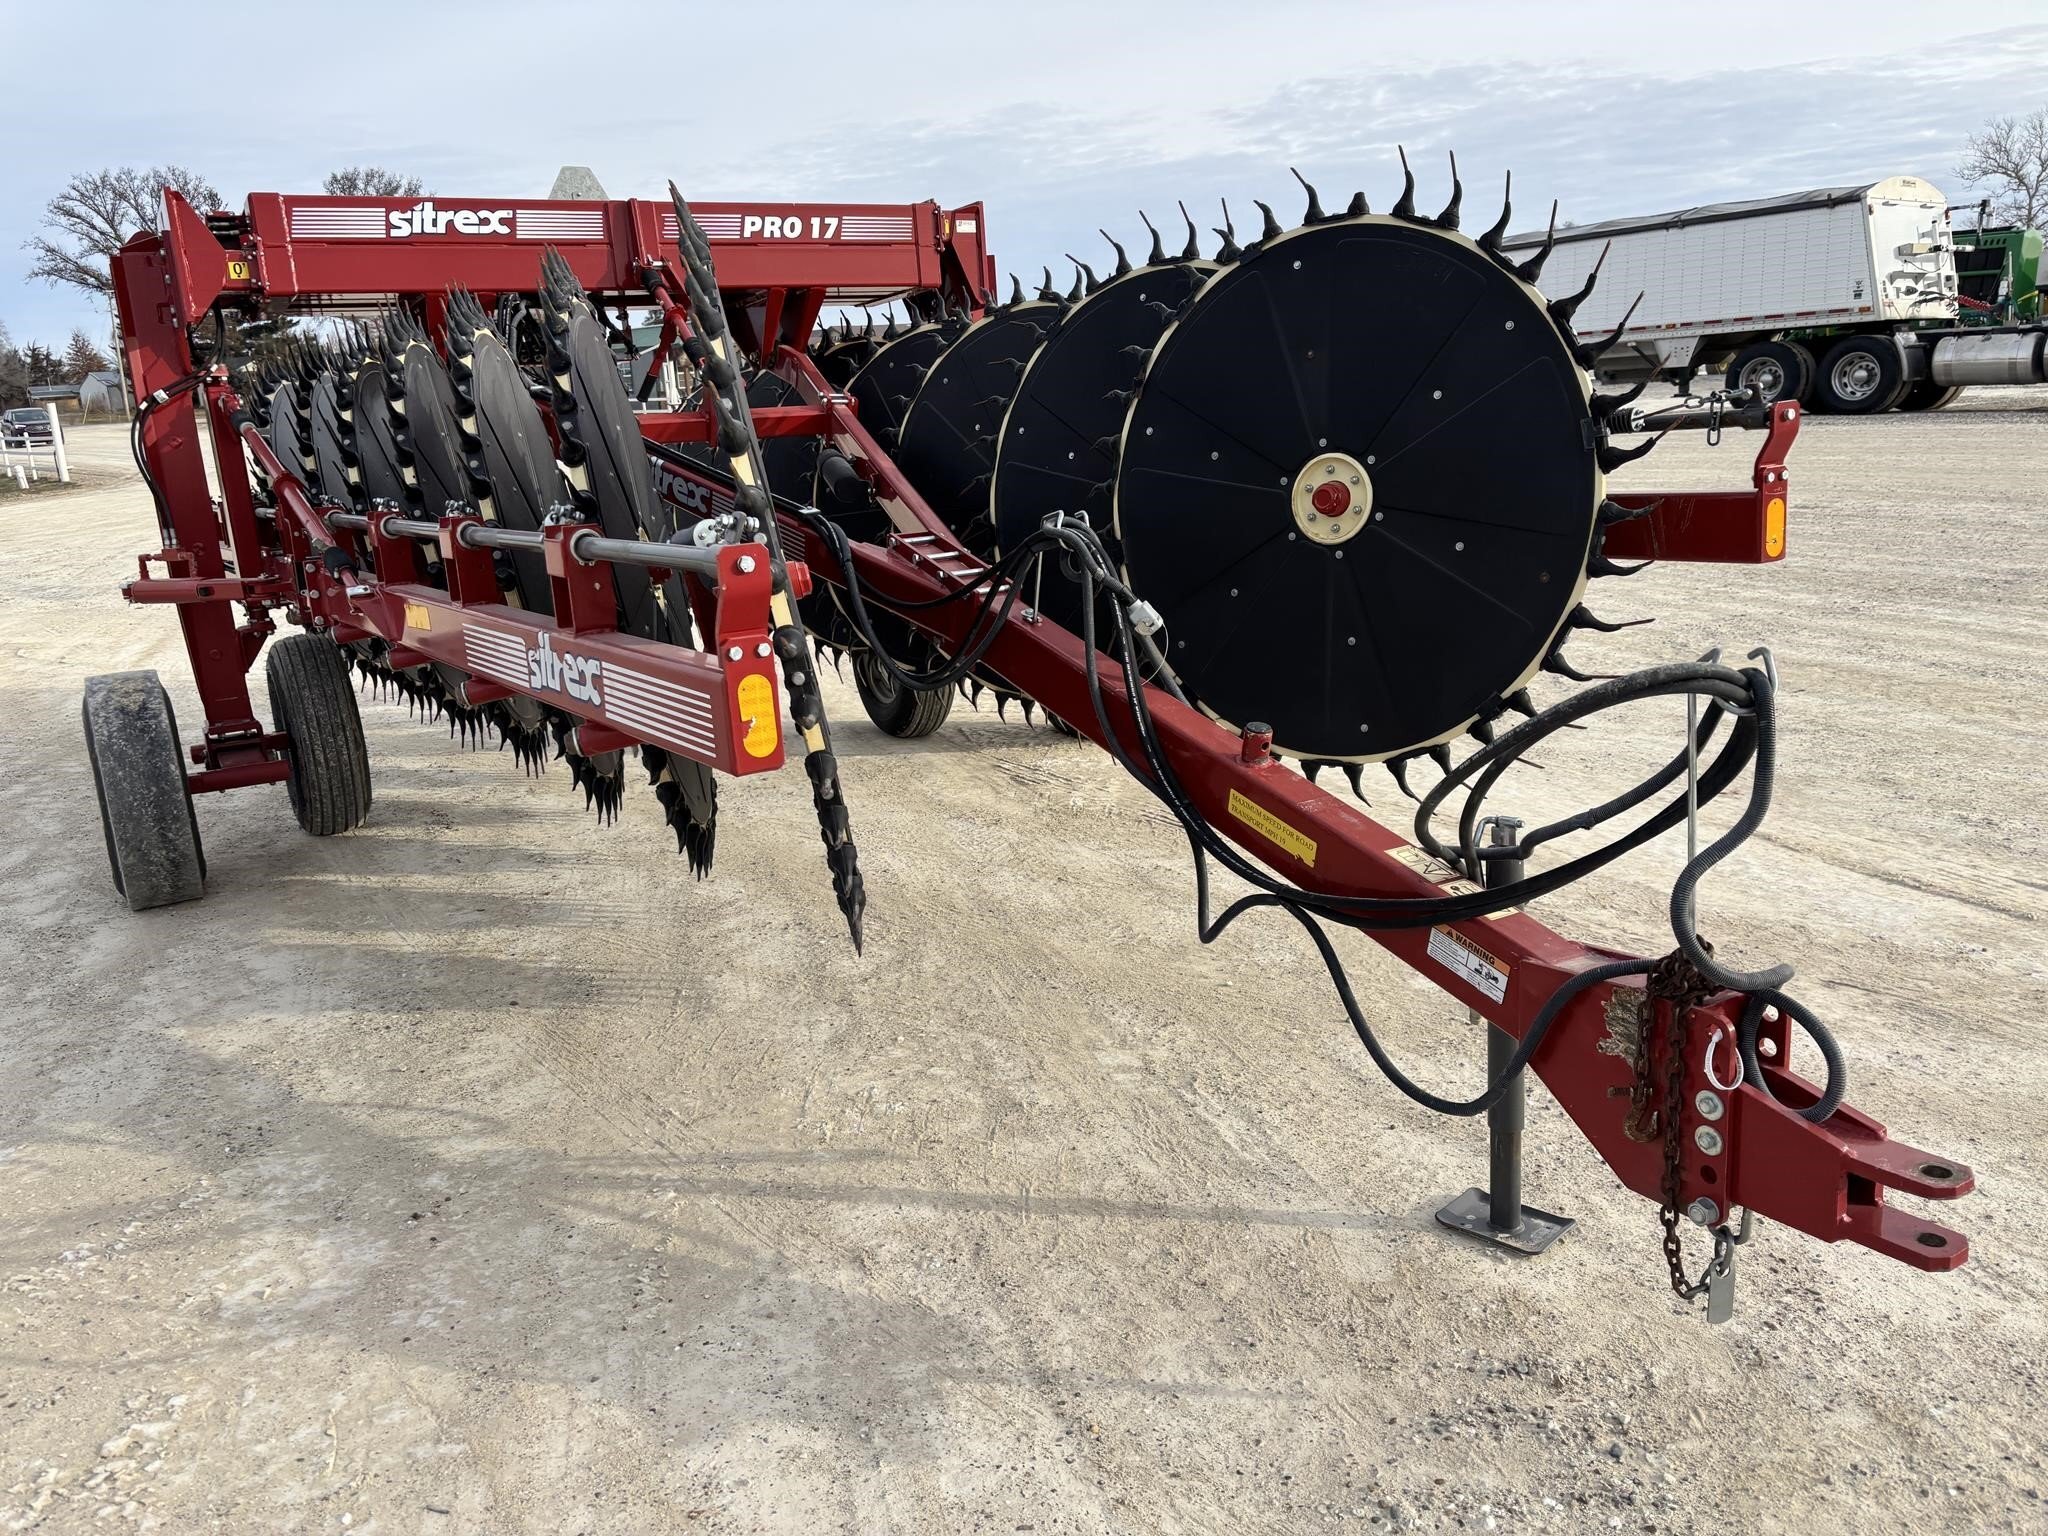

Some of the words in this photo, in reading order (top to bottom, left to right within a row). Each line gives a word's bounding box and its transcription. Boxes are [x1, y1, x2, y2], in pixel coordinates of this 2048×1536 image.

[388, 201, 513, 238] sitrex
[743, 216, 803, 239] PRO
[811, 217, 839, 239] 17
[527, 630, 602, 706] sitrex
[1231, 803, 1264, 831] TRANSPORT
[1264, 826, 1280, 841] MPH
[1232, 793, 1262, 818] MAXIMUM
[1262, 812, 1282, 830] SPEED
[1282, 825, 1295, 839] FOR
[1295, 834, 1314, 851] ROAD
[1455, 932, 1496, 966] WARNING
